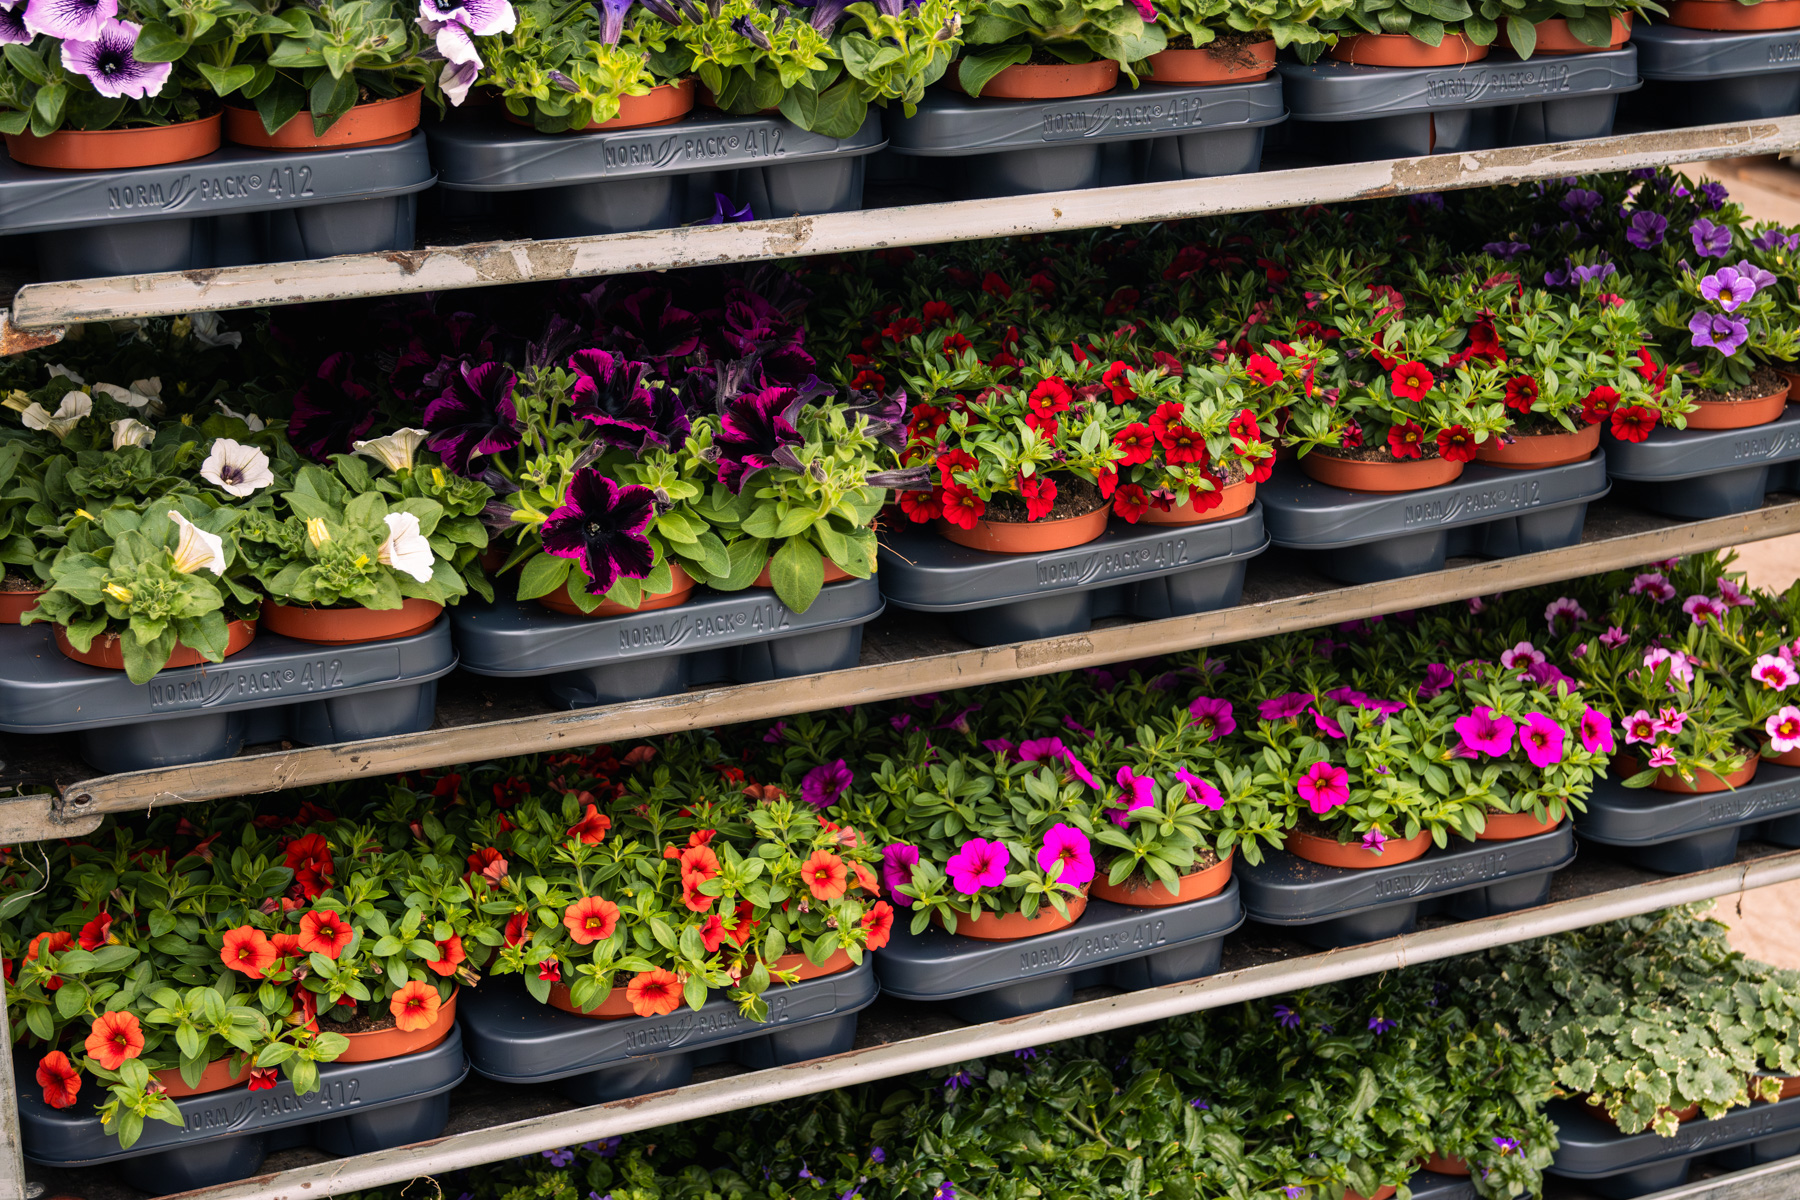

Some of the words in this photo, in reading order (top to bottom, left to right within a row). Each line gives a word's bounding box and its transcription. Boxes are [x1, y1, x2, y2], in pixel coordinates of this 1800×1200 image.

[1427, 77, 1467, 99] NORM
[1538, 64, 1570, 92] 412
[1043, 111, 1087, 135] NORM
[1167, 97, 1203, 126] 412
[605, 142, 655, 168] NORM
[744, 128, 786, 158] 412
[108, 182, 165, 210] NORM
[267, 165, 315, 200] 412
[1405, 500, 1443, 524] NORM
[1510, 480, 1541, 508] 412
[1038, 560, 1080, 586] NORM
[1154, 538, 1189, 568] 412
[619, 623, 667, 650] NORM
[751, 604, 790, 634] 412
[151, 681, 205, 707] NORM
[300, 658, 344, 691] 412
[1374, 874, 1413, 898] NORM
[1478, 852, 1508, 879] 412
[1020, 945, 1060, 971] NORM
[1132, 919, 1166, 949] 412
[625, 1023, 671, 1050] NORM
[758, 996, 790, 1028] 12
[320, 1077, 361, 1110] 412
